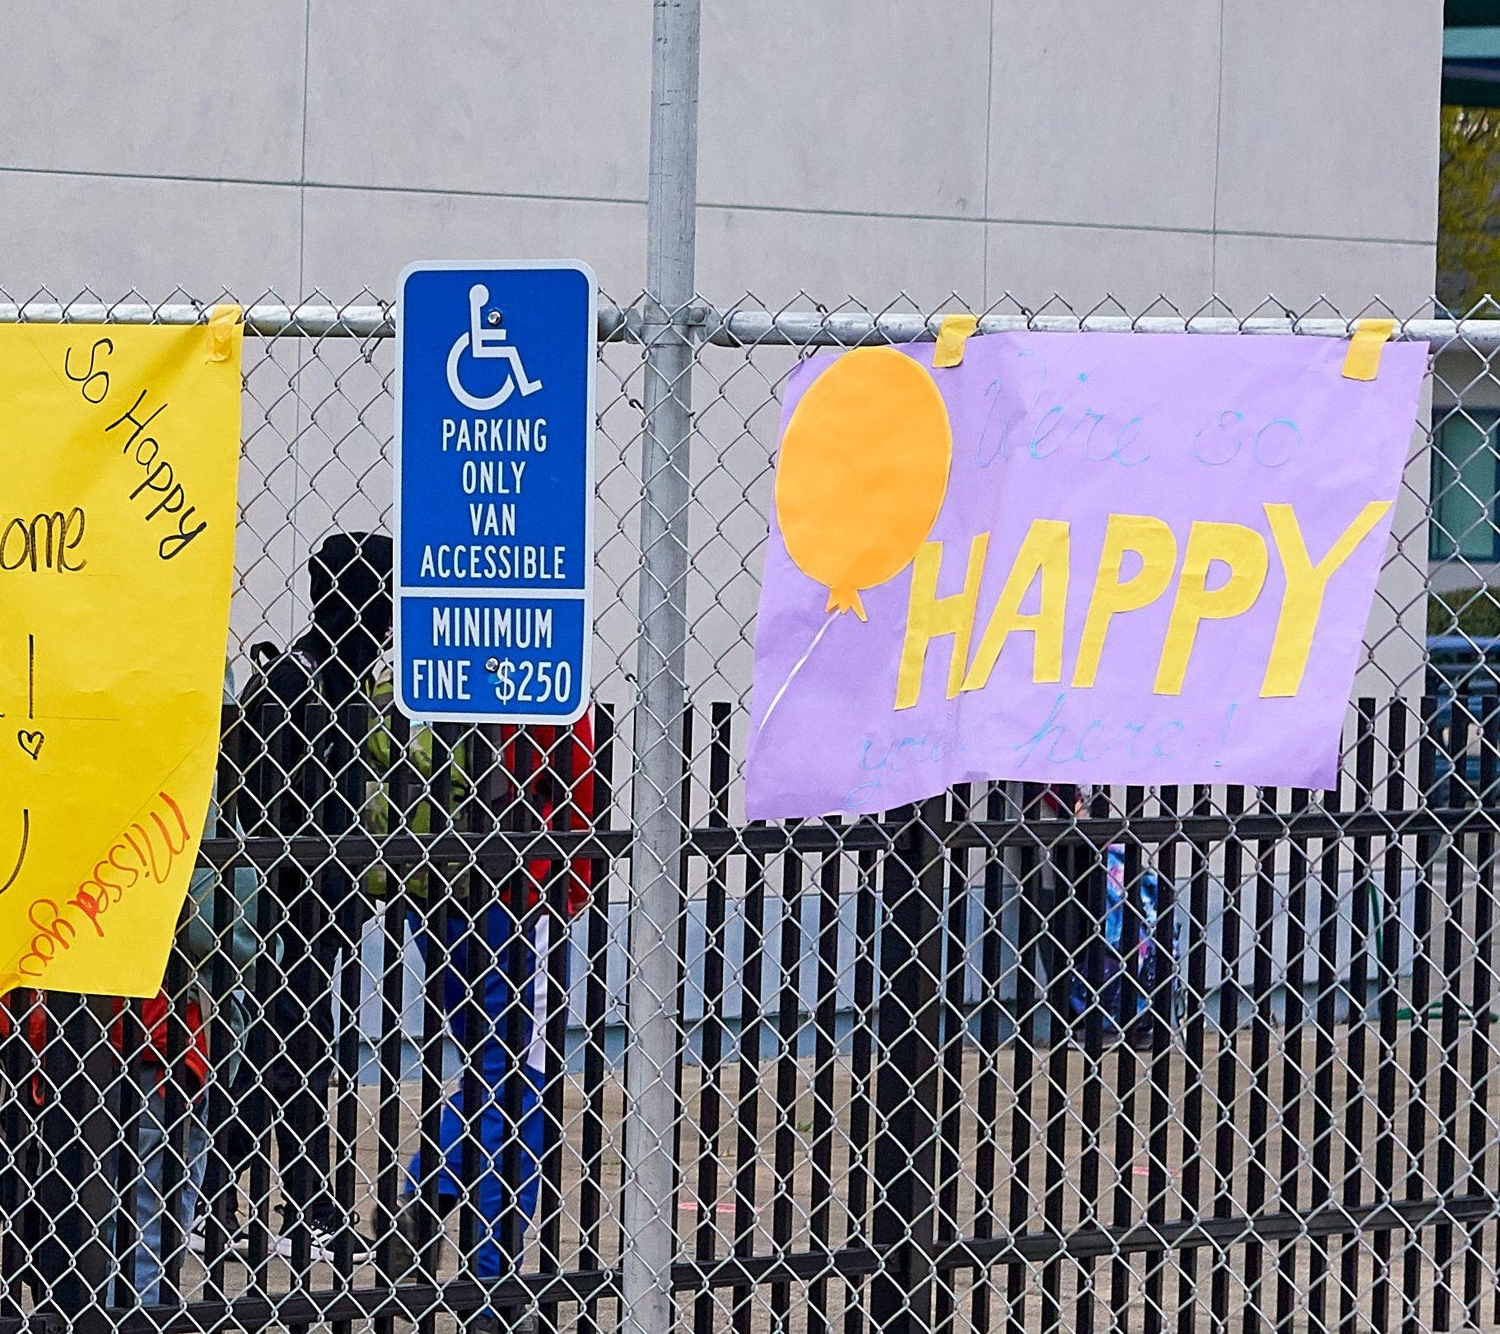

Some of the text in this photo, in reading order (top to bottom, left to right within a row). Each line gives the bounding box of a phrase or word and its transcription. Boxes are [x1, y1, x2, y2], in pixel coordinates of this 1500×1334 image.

[64, 337, 207, 560] So Happy
[442, 418, 548, 453] PARKING
[461, 461, 527, 495] ONLY
[469, 503, 517, 537] VAN
[419, 544, 567, 580] ACCESSIBLE
[892, 500, 1394, 711] HAPPY
[431, 607, 553, 649] MINIMUM
[412, 657, 573, 706] FINE $250
[18, 790, 191, 977] Missed you
